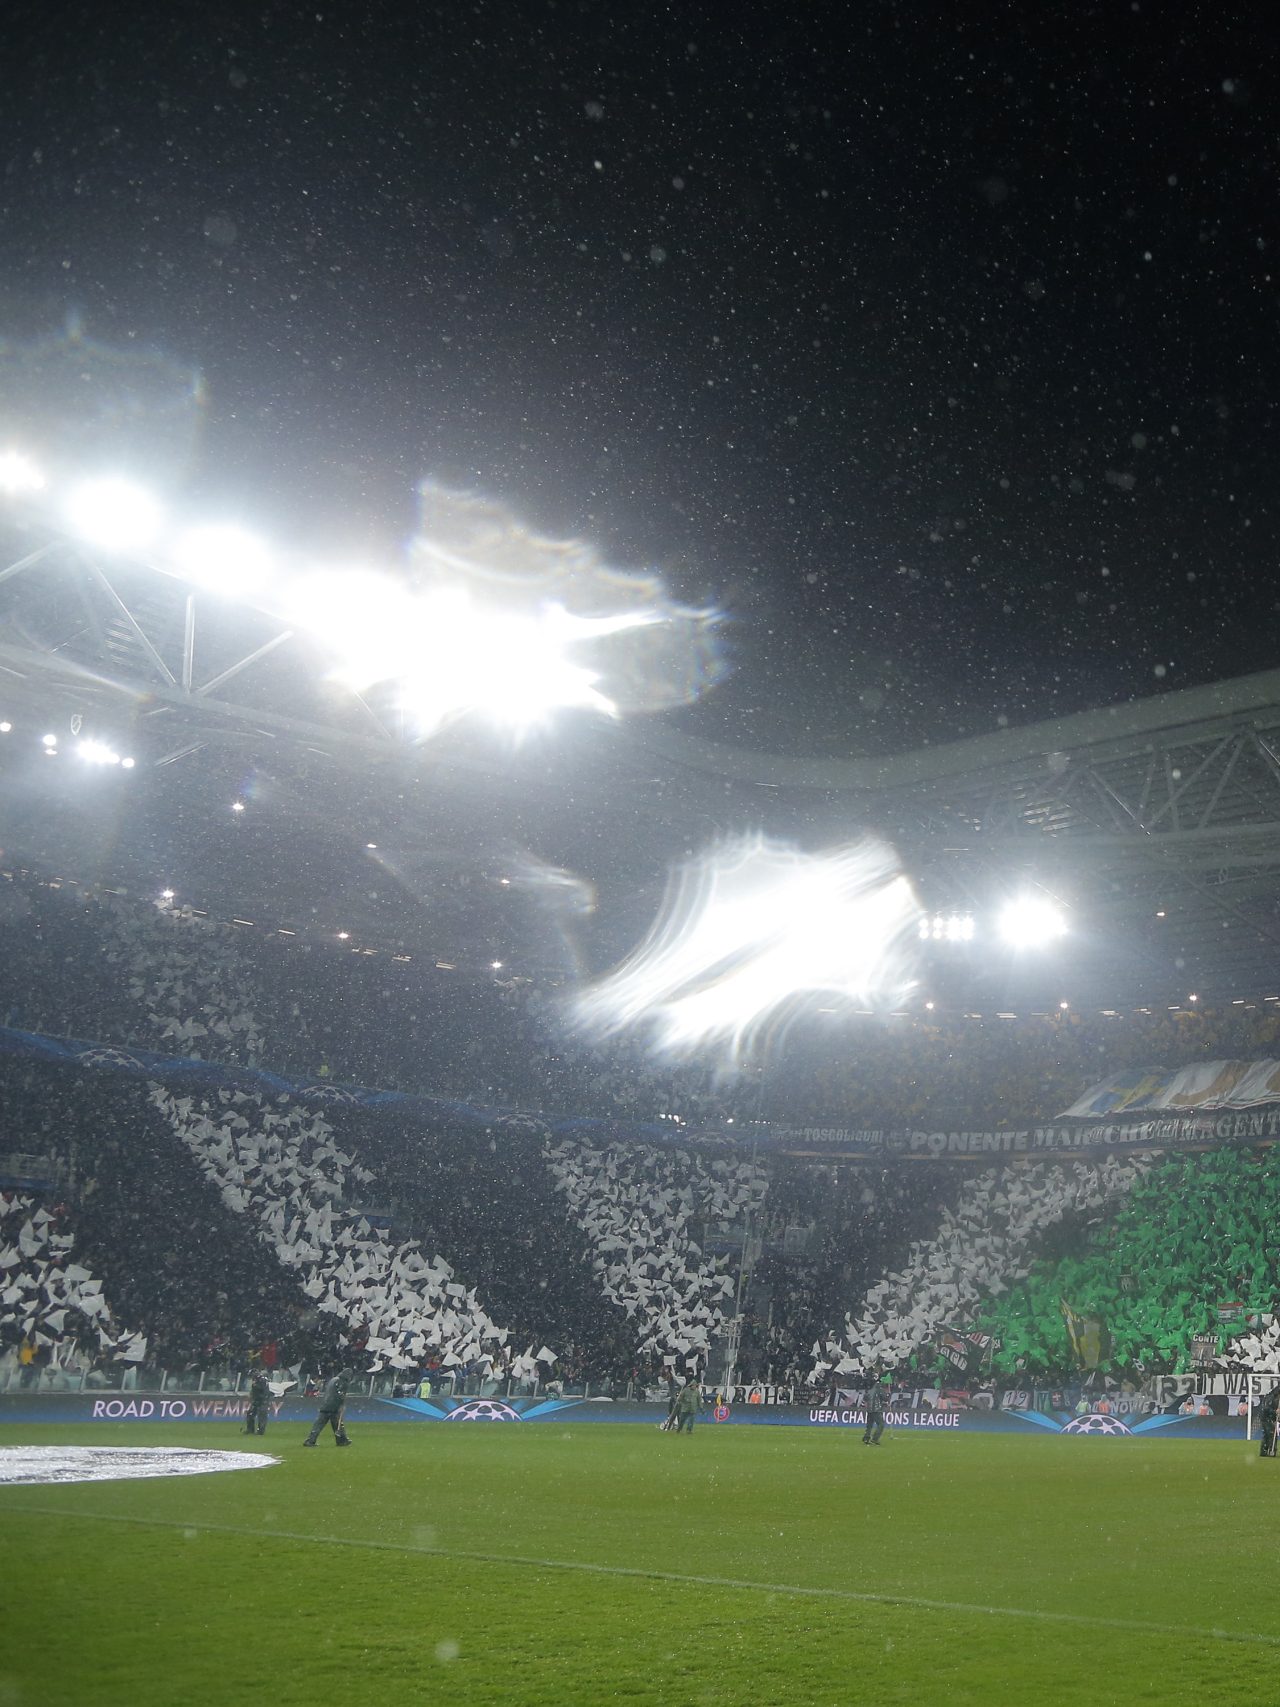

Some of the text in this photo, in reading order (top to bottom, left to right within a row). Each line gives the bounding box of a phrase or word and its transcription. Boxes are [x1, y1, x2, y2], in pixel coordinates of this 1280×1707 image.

[911, 1131, 1029, 1152] PONENTE
[92, 1400, 155, 1418] ROAD
[159, 1401, 187, 1418] TO
[809, 1409, 839, 1423] UEFA
[913, 1412, 961, 1428] LEAGUE
